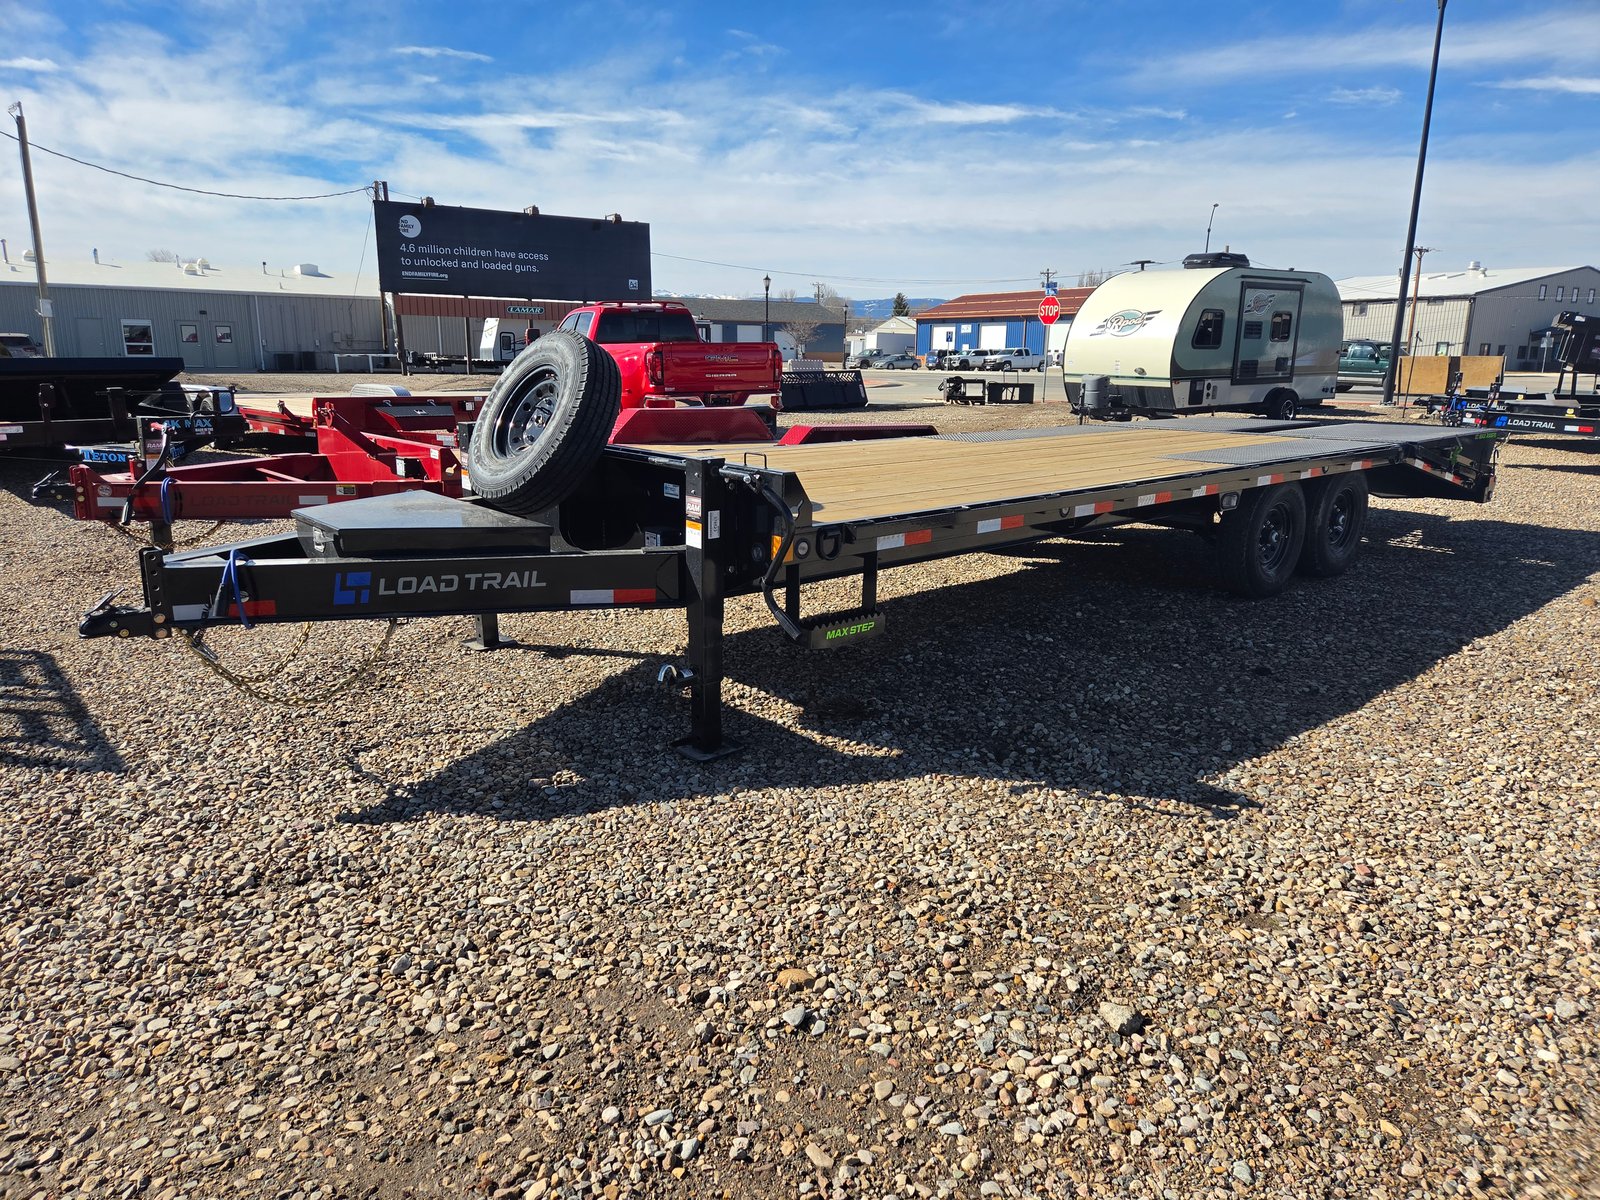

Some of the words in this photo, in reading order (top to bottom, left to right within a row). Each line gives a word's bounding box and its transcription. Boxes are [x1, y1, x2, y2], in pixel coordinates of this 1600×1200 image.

[400, 243, 416, 253] 4.6
[418, 244, 451, 255] million
[453, 246, 492, 257] children
[494, 249, 516, 259] have
[517, 252, 549, 261] access
[401, 257, 412, 266] to
[414, 257, 459, 268] unlocked
[461, 260, 479, 269] and
[481, 260, 513, 271] loaded
[514, 263, 540, 273] guns.
[509, 306, 541, 314] LAMAR
[1040, 305, 1059, 317] STOP
[1507, 419, 1530, 427] LOAD
[1531, 420, 1556, 429] TRAIL
[81, 448, 126, 463] TETON
[378, 573, 460, 596] LOAD
[464, 570, 547, 591] TRAIL
[826, 625, 849, 640] MAX
[849, 621, 875, 636] STEP
